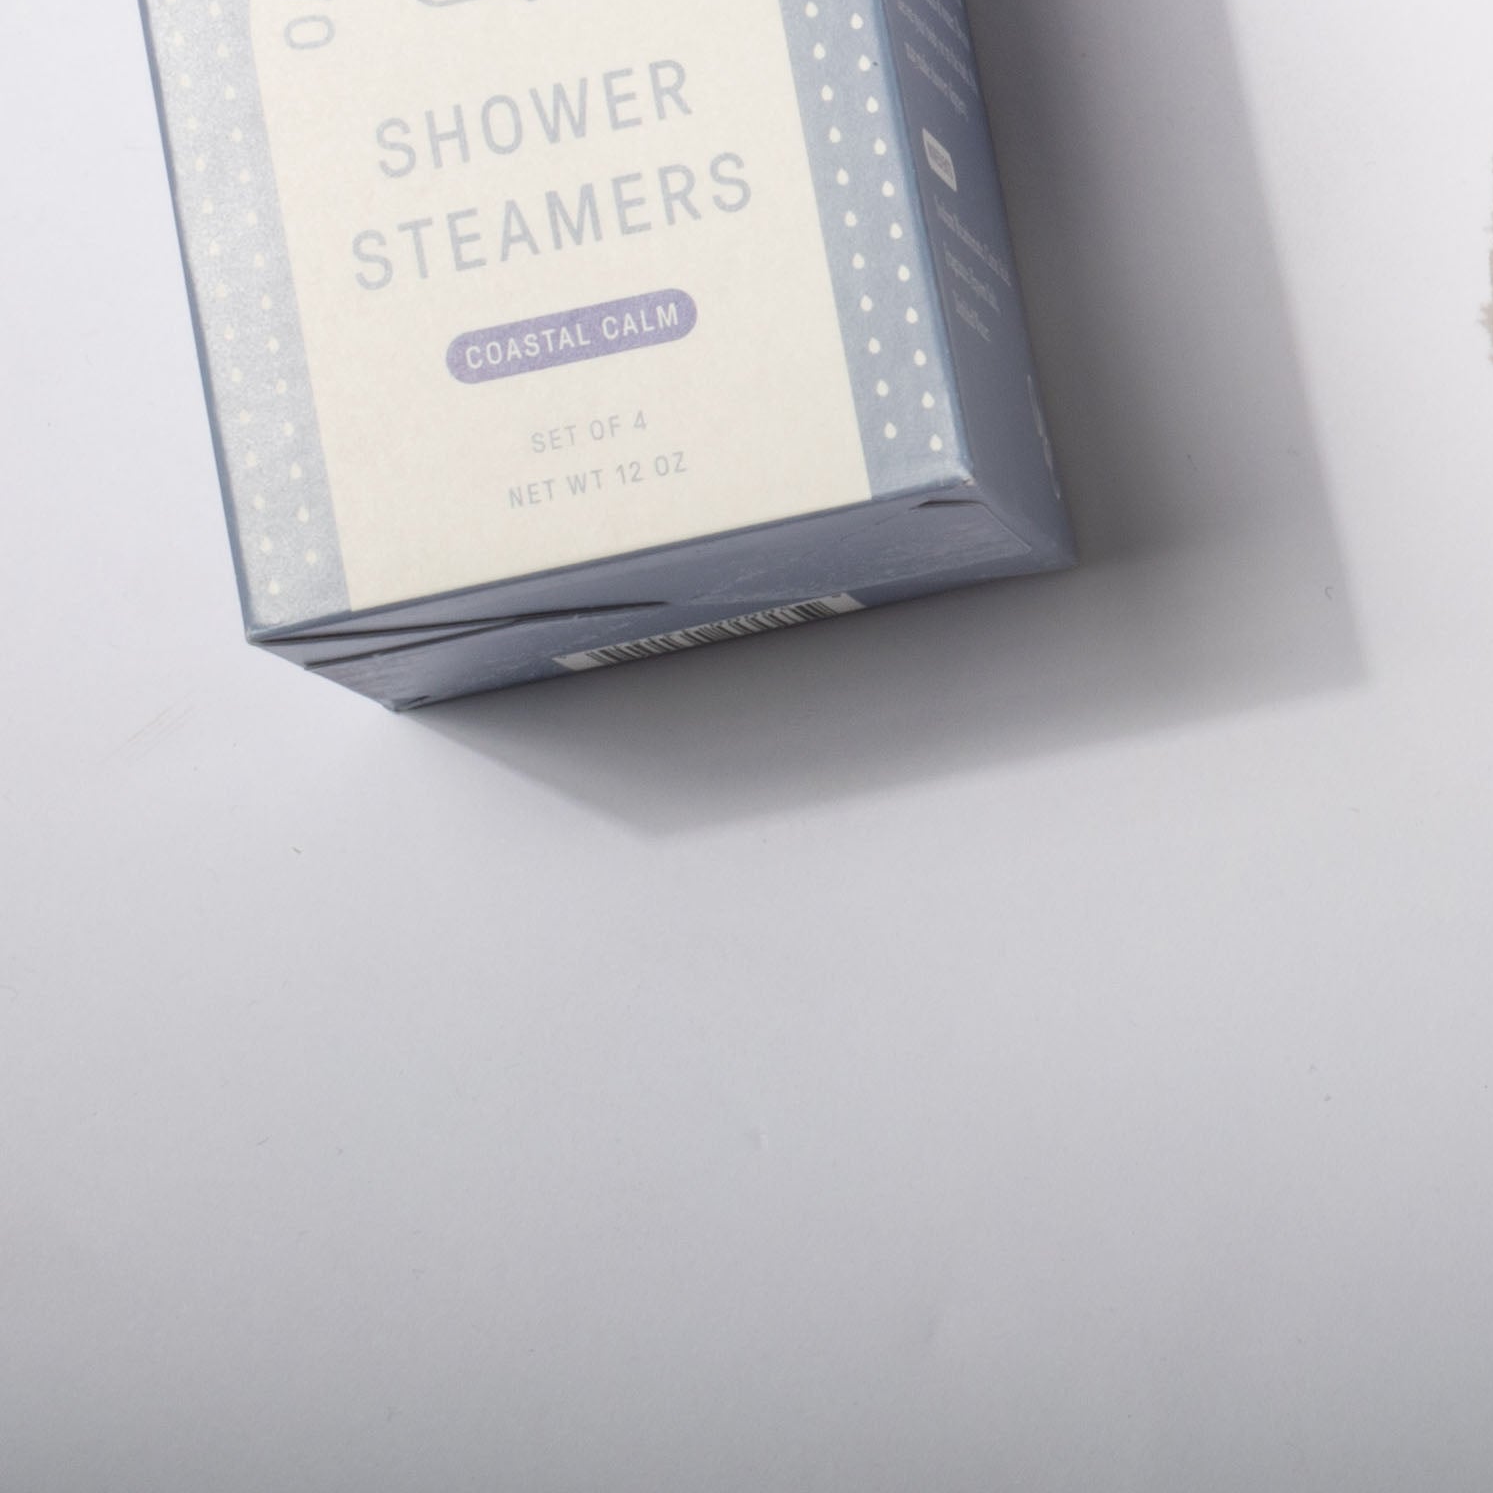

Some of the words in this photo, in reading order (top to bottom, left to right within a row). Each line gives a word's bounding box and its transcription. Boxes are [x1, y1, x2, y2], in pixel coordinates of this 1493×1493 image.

[375, 58, 694, 179] SHOWER
[351, 151, 752, 291] STEAMERS
[464, 322, 592, 370] COASTAL
[601, 302, 679, 341] CALM
[530, 424, 577, 454] SET
[588, 414, 622, 442] OF
[632, 409, 648, 431] 4
[507, 478, 556, 509] NET
[565, 468, 604, 497] WT
[615, 460, 645, 486] 12
[653, 450, 688, 478] OZ
